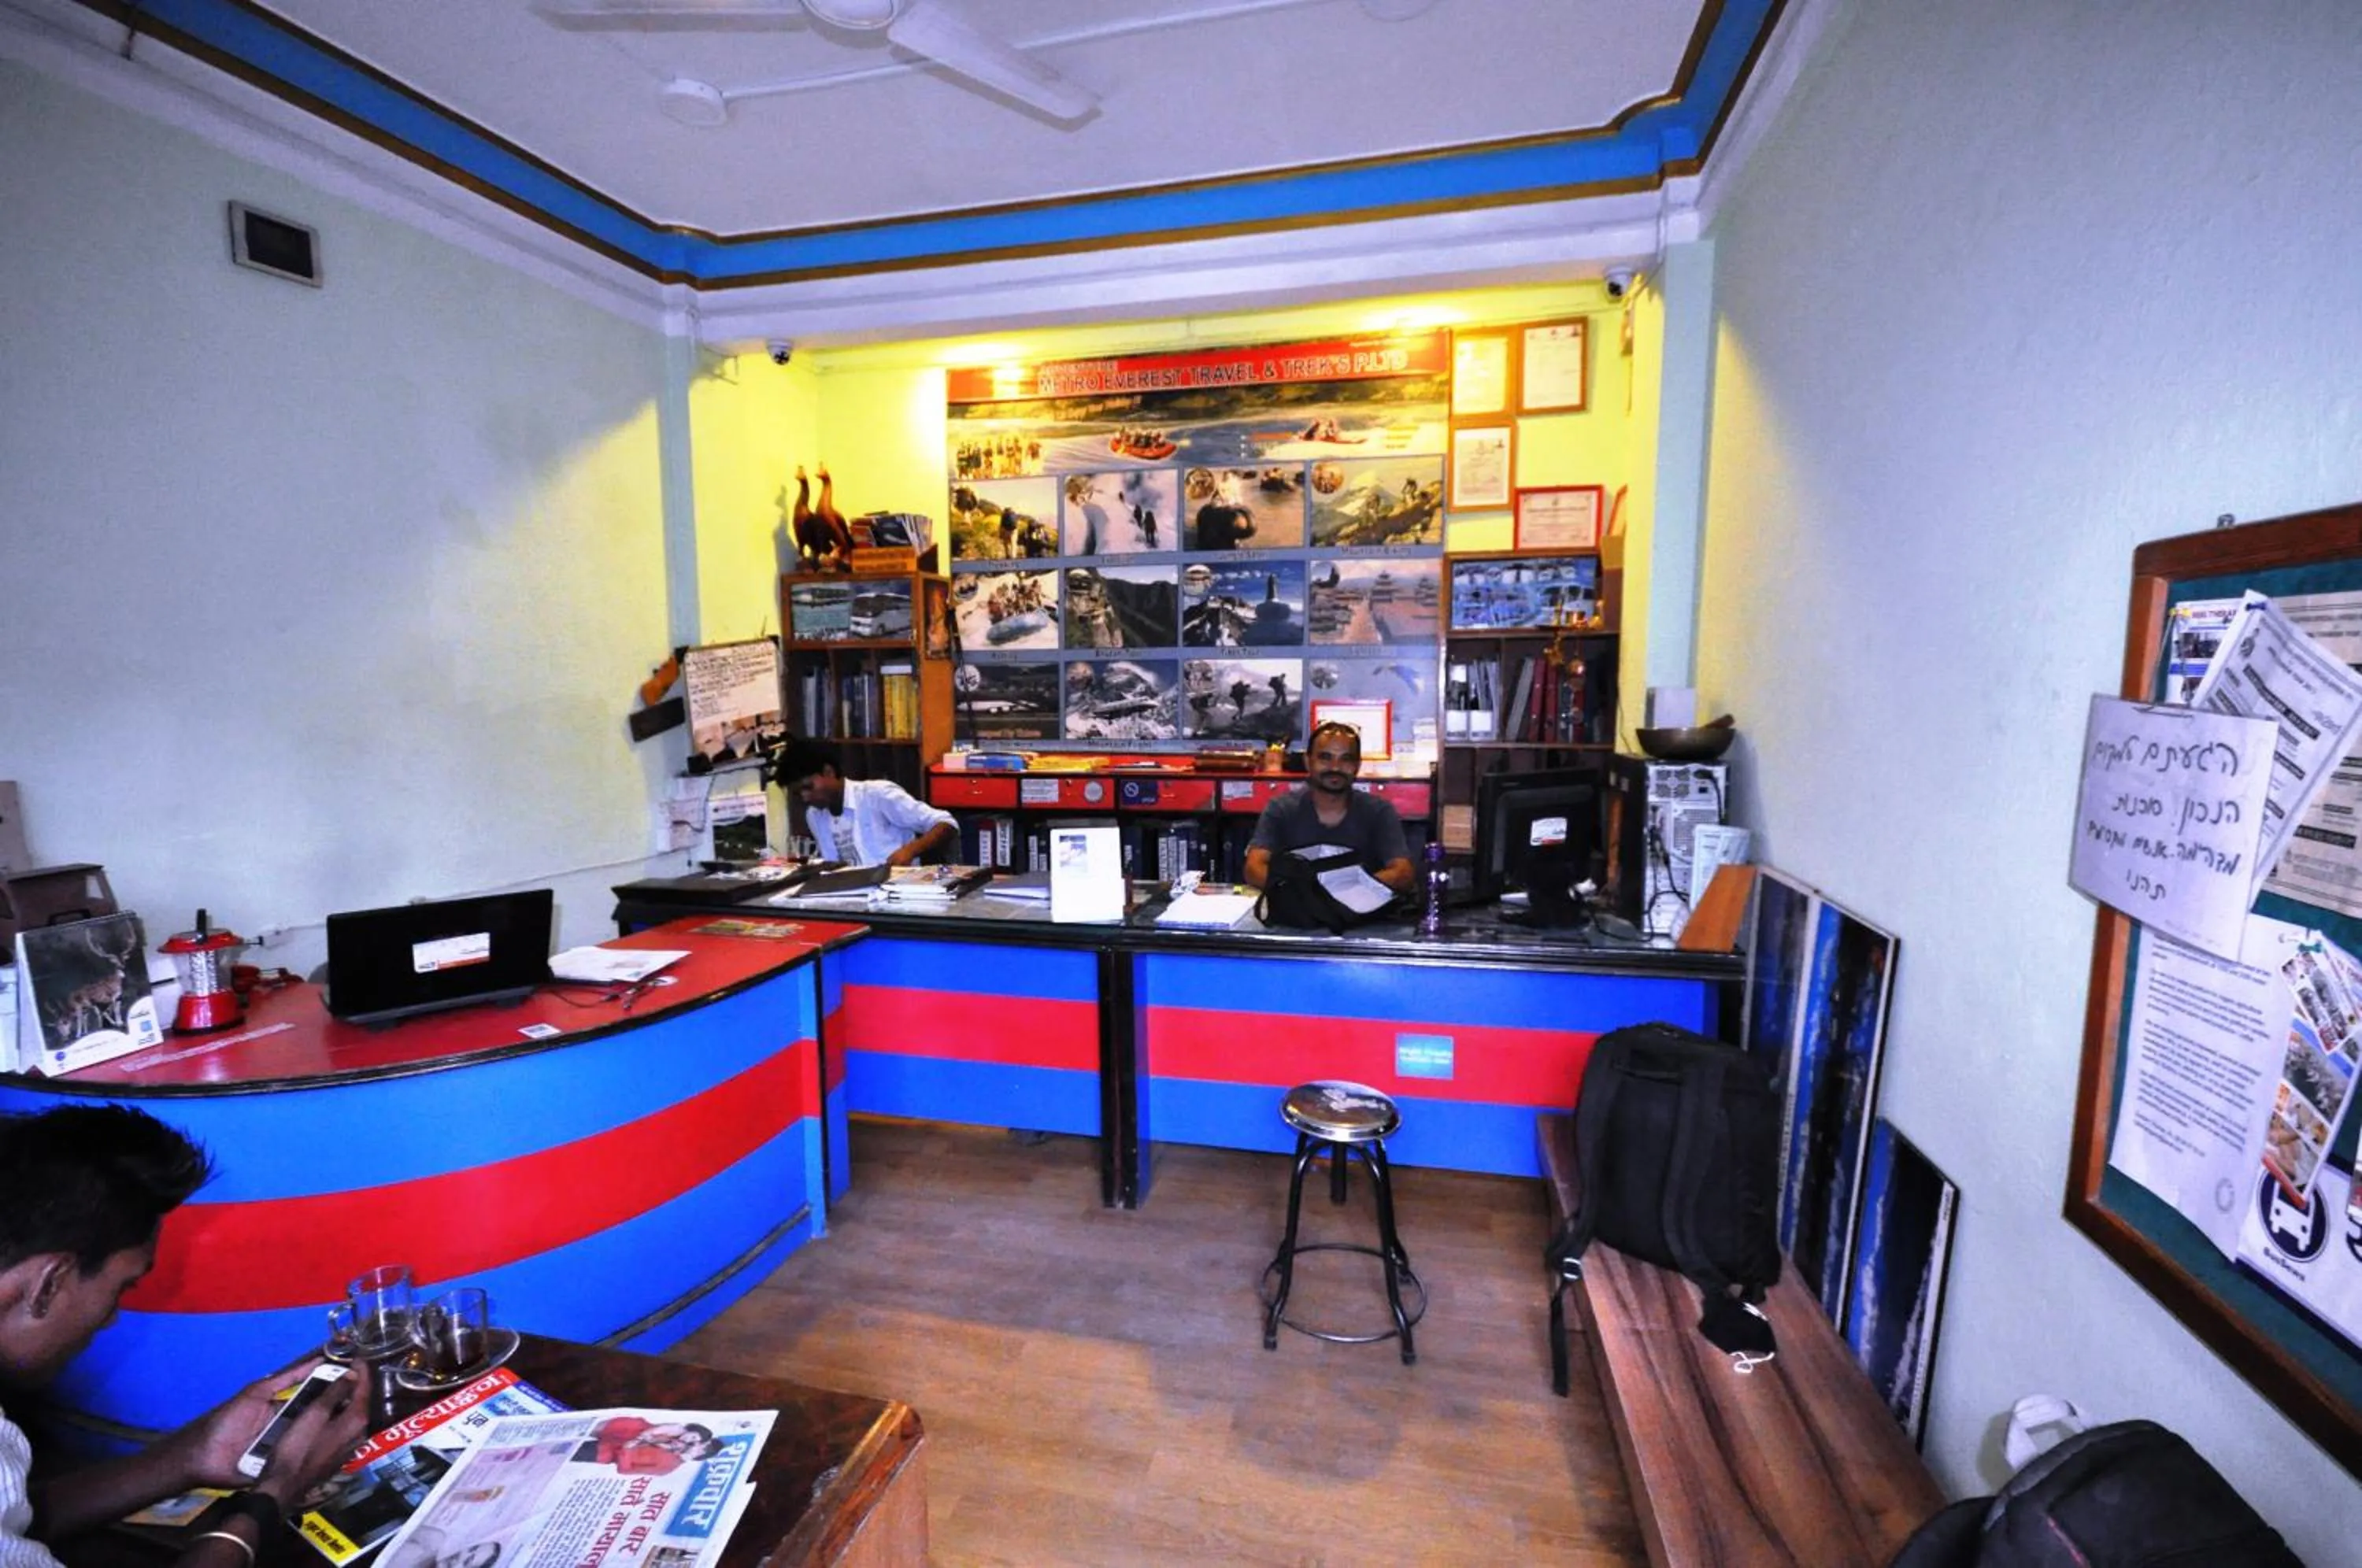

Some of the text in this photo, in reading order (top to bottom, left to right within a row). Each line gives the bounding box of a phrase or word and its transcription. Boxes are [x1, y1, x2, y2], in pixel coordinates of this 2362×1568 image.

[1038, 371, 1100, 394] METRO
[1103, 368, 1183, 391] EVEREST
[1187, 364, 1260, 386] TRAVEL
[1263, 360, 1277, 379] &
